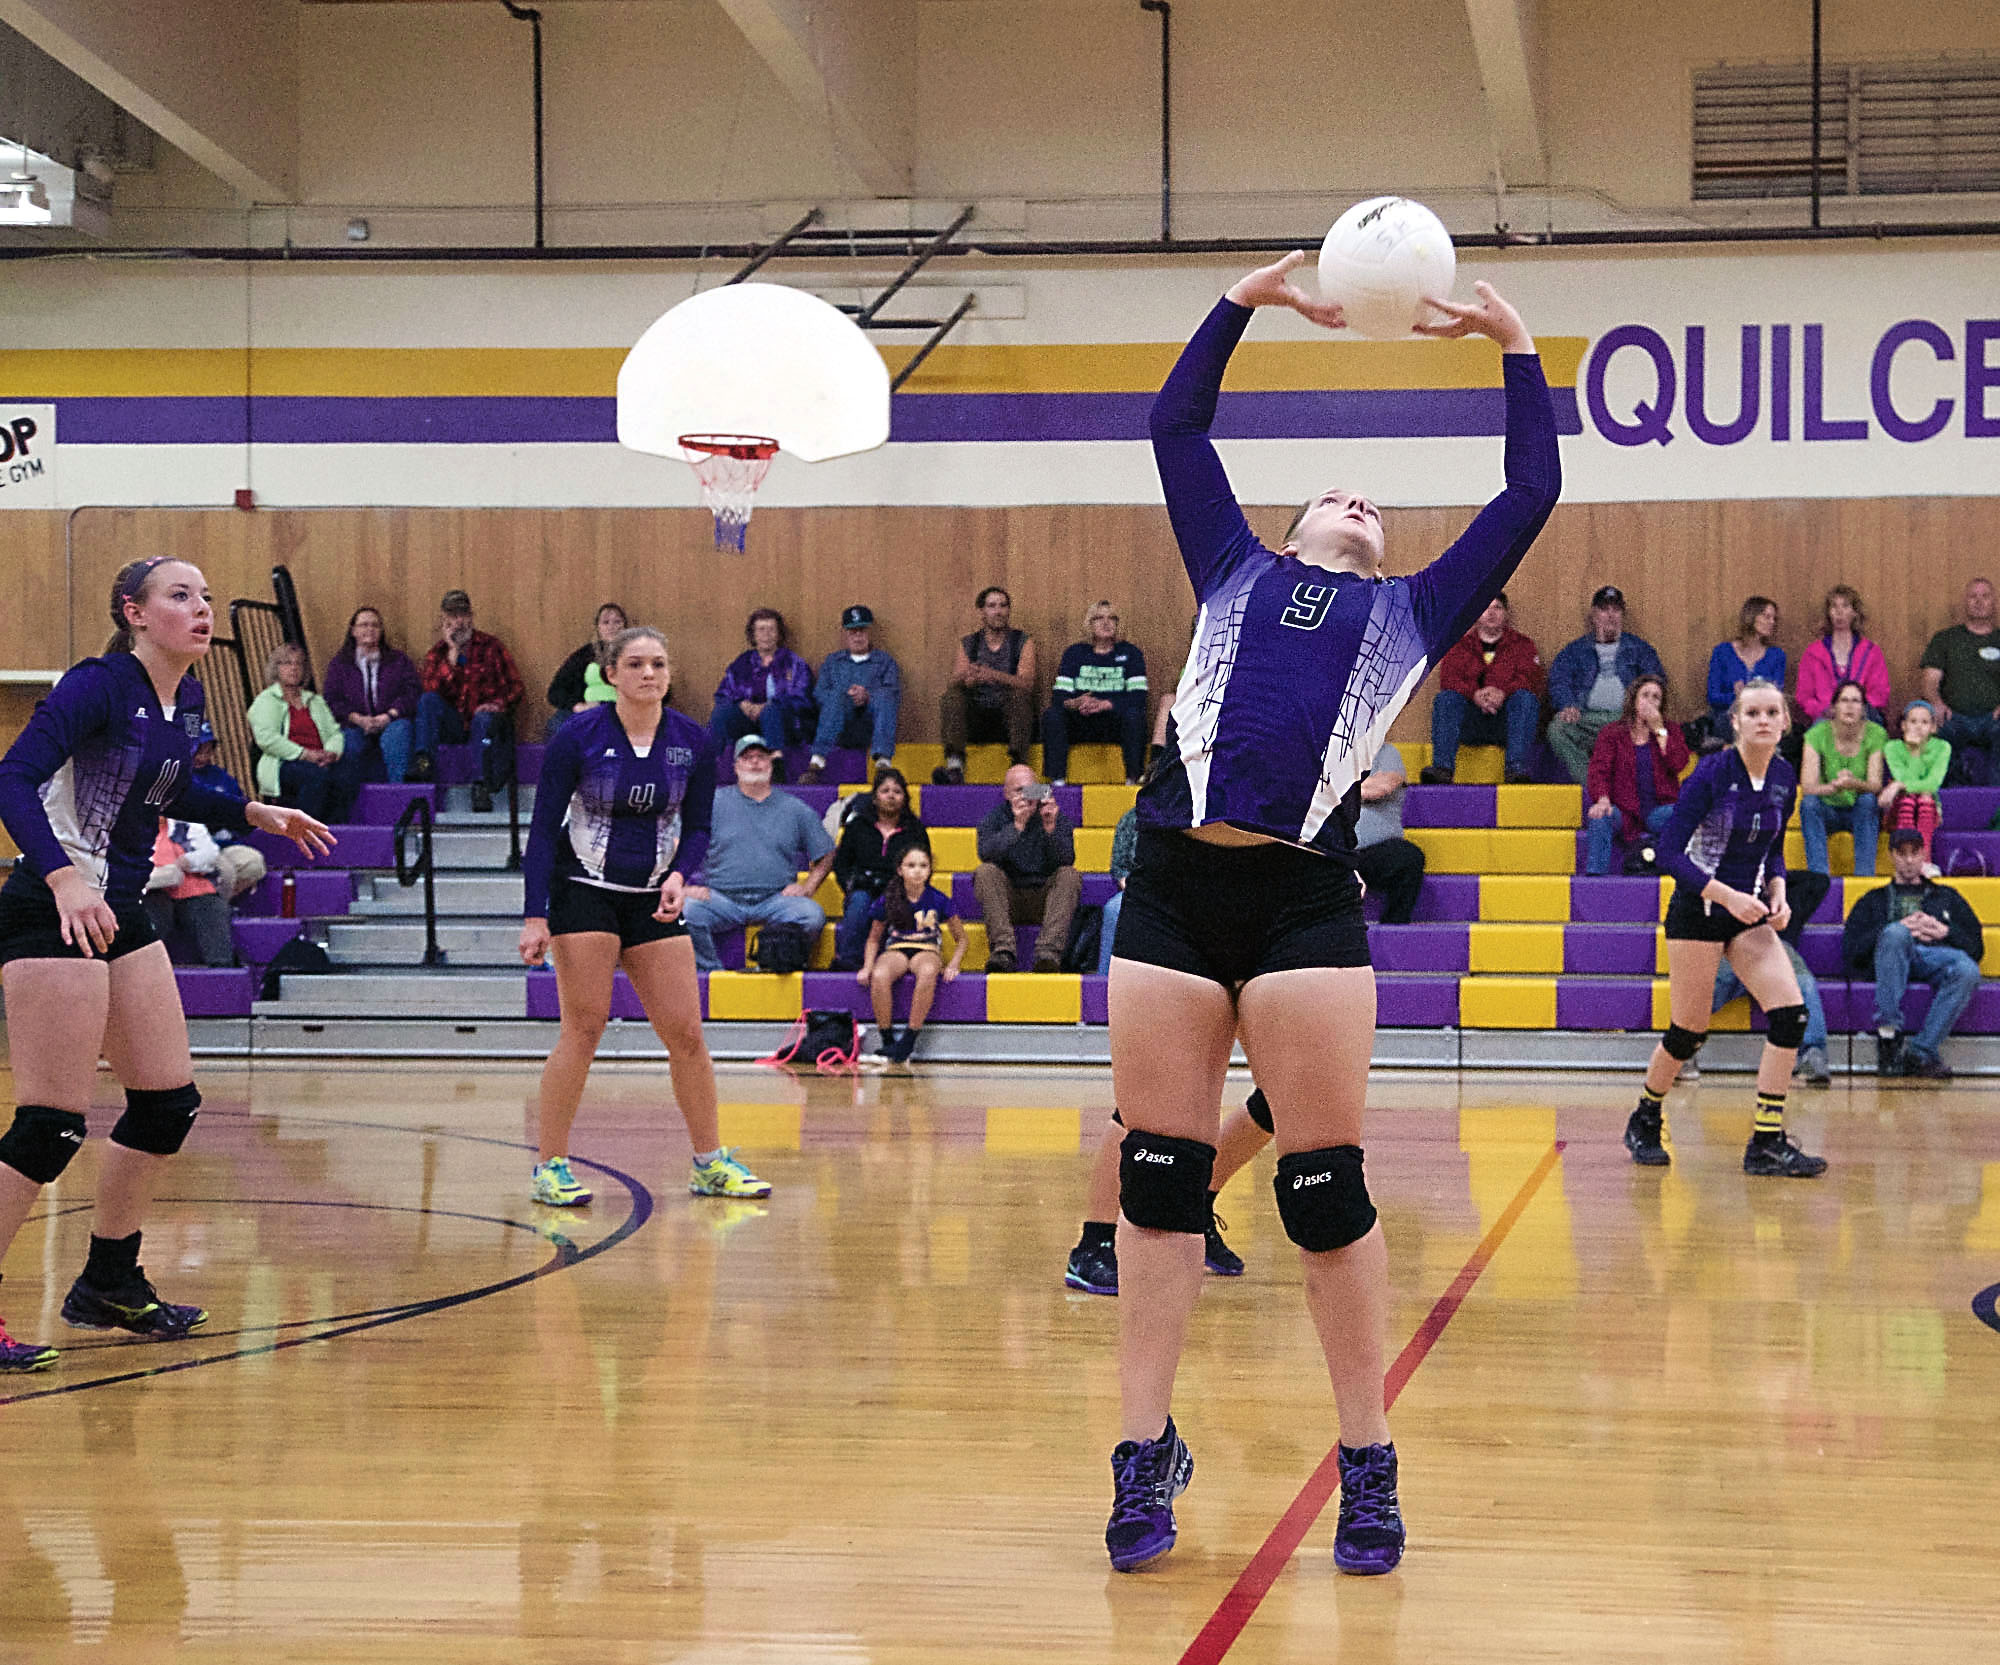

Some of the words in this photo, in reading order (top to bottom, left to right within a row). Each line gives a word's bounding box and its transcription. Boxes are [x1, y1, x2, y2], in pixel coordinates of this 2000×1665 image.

[9, 458, 45, 483] GYM
[1280, 582, 1339, 631] 9
[144, 758, 180, 805] 11
[627, 783, 656, 813] 4
[1145, 1152, 1175, 1165] asics
[1304, 1171, 1332, 1186] asics
